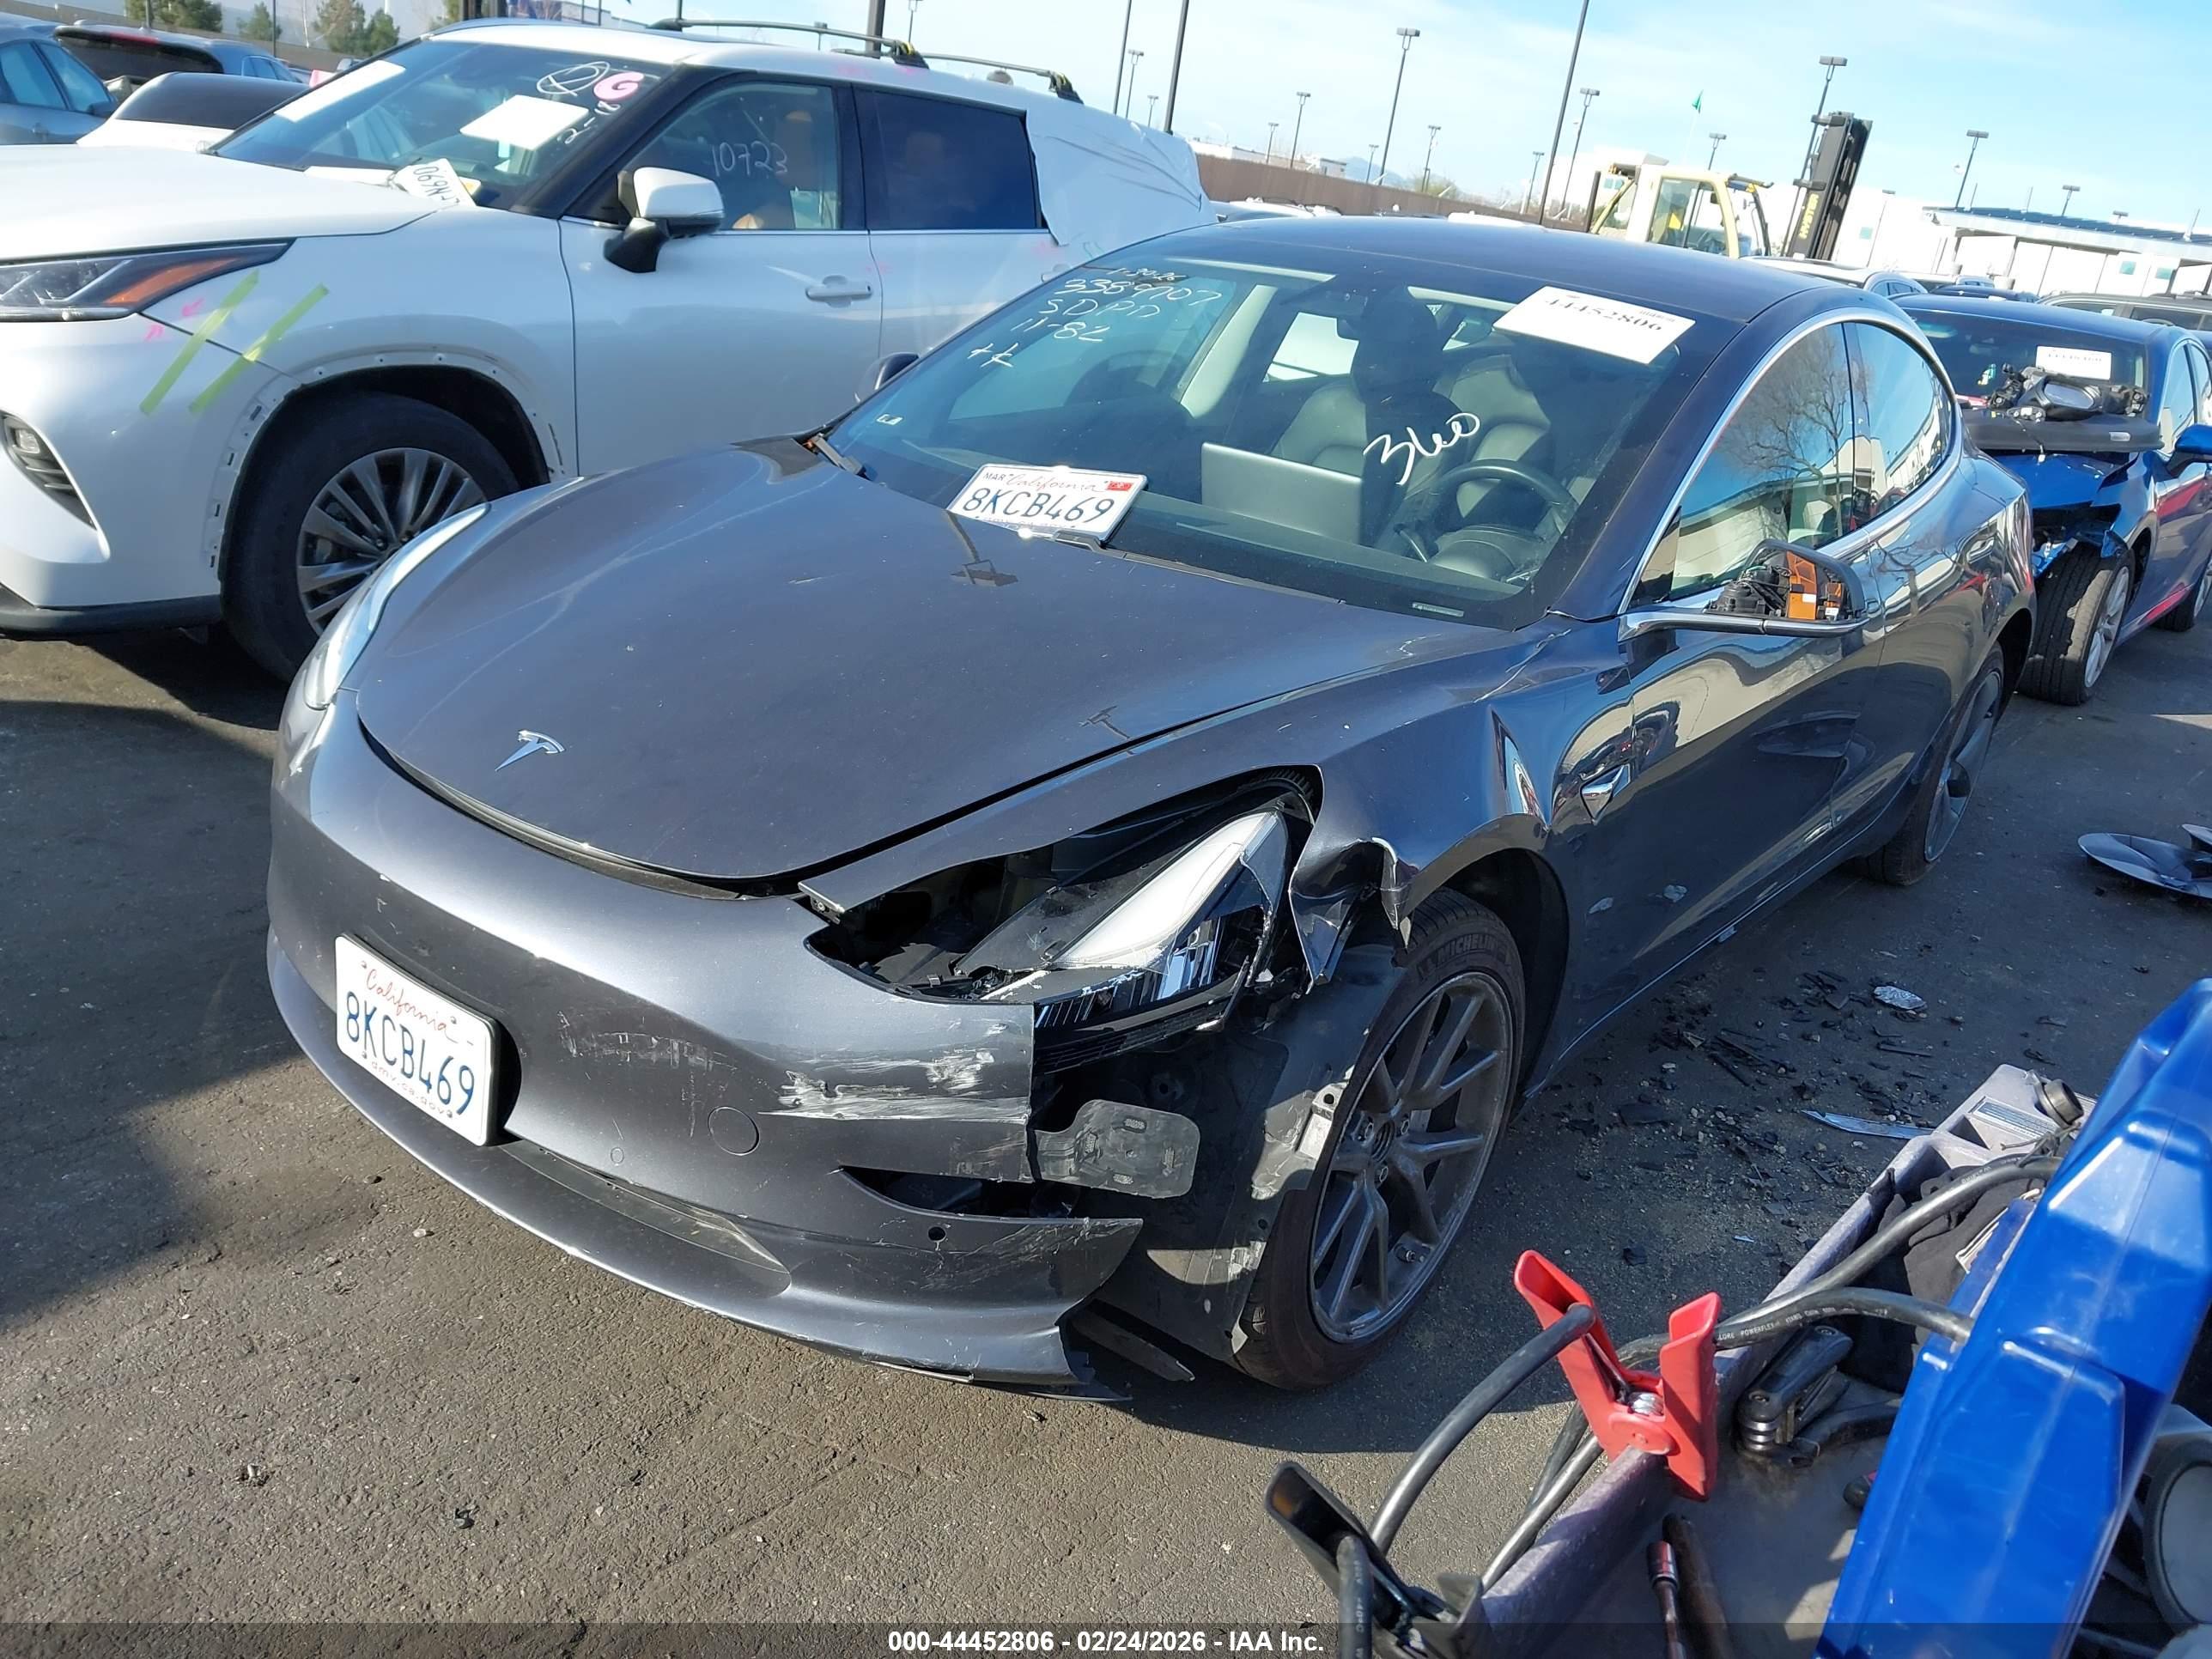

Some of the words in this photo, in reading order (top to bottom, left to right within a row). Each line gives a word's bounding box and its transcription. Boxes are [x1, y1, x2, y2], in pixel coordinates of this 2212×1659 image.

[711, 141, 788, 178] 10723
[983, 471, 1005, 482] MAR
[1006, 473, 1104, 493] California
[963, 487, 1115, 524] 8KCB469
[366, 969, 459, 1044] California
[346, 990, 476, 1116] 8KCB469
